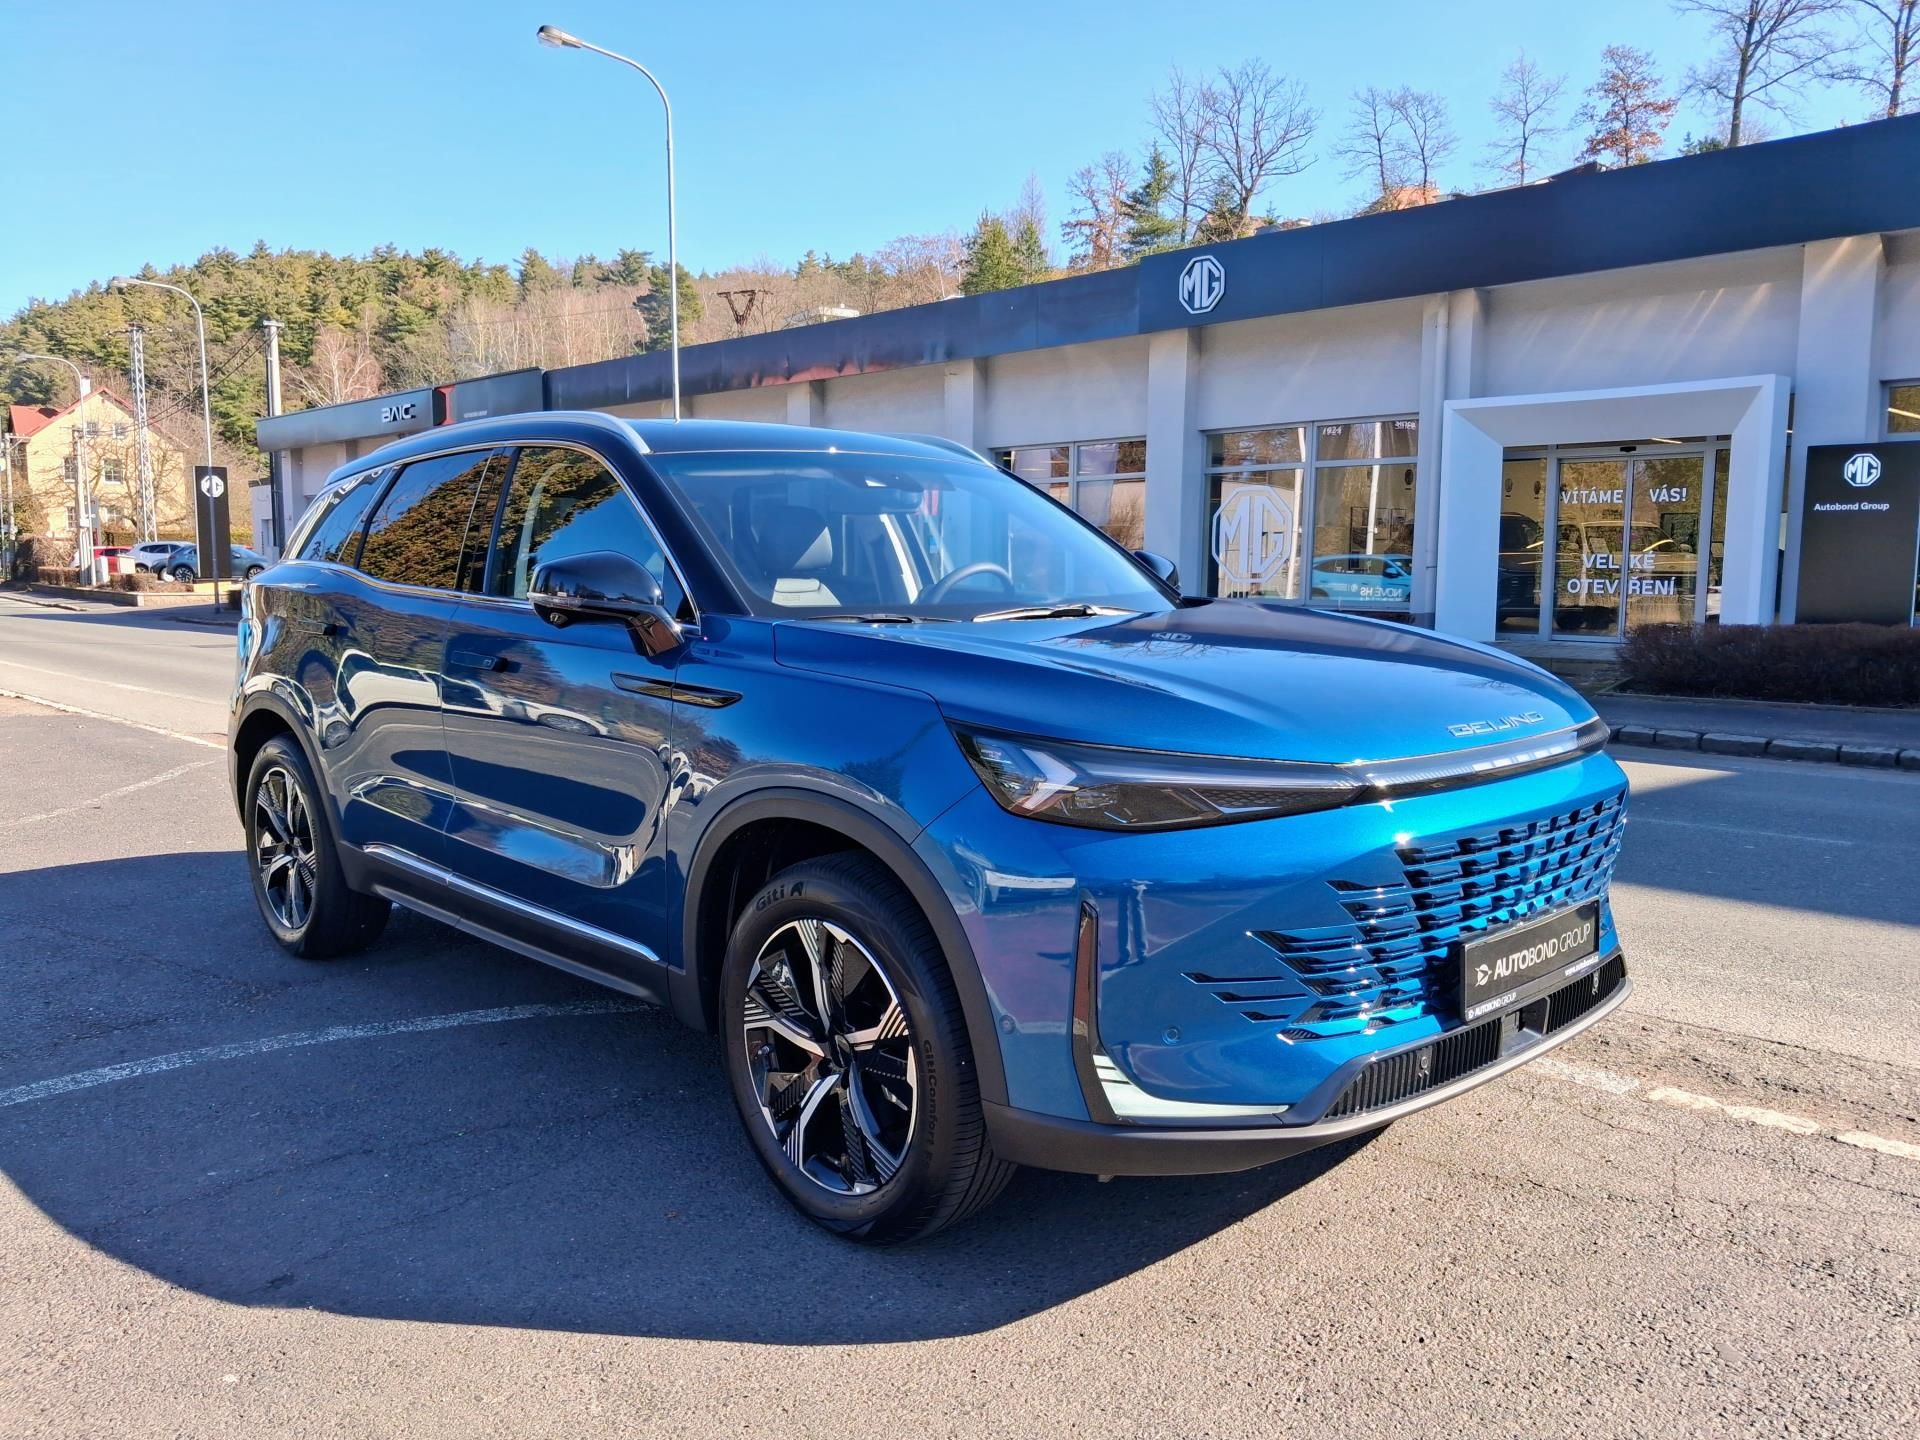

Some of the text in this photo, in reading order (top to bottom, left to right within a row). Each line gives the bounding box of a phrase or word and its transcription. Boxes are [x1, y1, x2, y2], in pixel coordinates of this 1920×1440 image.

[1182, 259, 1222, 310] MG
[1846, 456, 1879, 484] MG
[1562, 484, 1687, 504] VÍTÁME VÁS!
[1814, 502, 1890, 511] Autobond Group
[1218, 495, 1285, 575] MG
[1567, 577, 1676, 595] OTEVŘENÍ
[1447, 711, 1544, 737] BEIJING
[756, 884, 785, 912] Giti
[1493, 922, 1591, 980] AUTOBOND GROUP
[1474, 999, 1501, 1016] AUTOBOND
